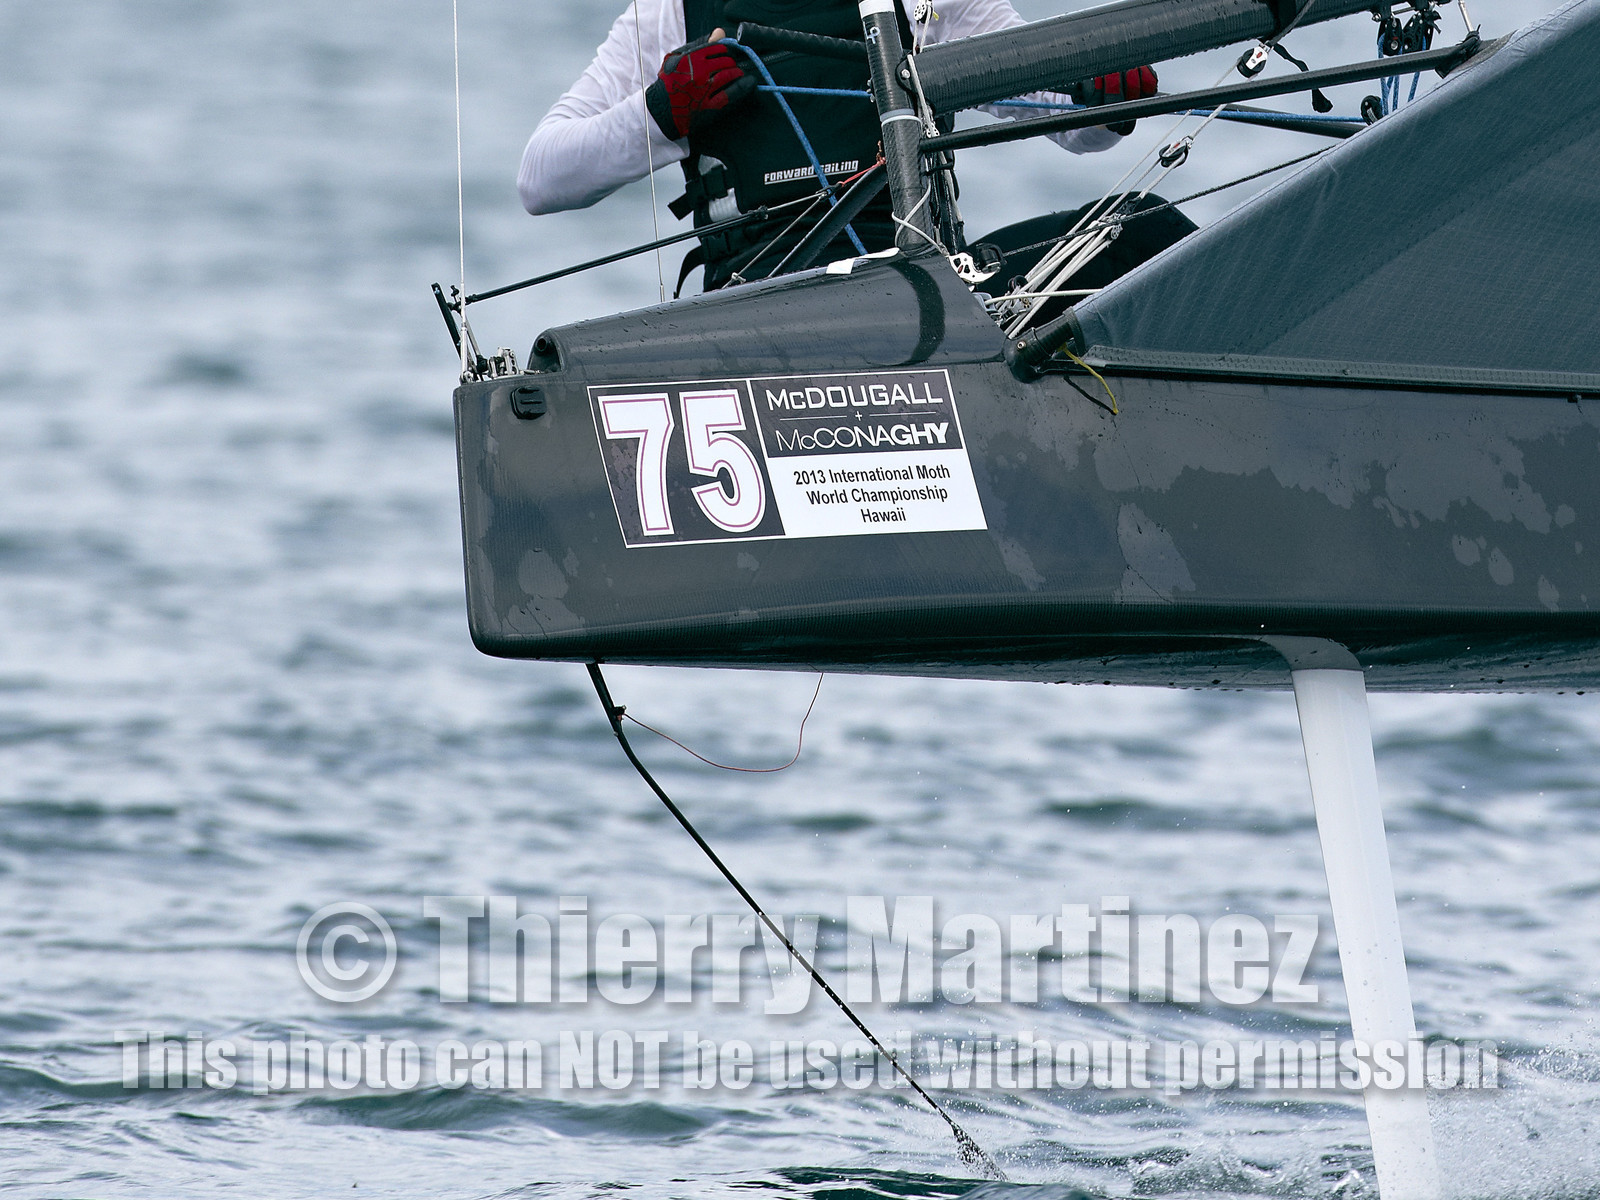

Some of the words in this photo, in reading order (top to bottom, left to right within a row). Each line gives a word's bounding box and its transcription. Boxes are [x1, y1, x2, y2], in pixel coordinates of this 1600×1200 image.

[765, 382, 944, 411] McDOUGALL
[775, 421, 949, 451] McCONAGHY
[597, 388, 766, 537] 75
[793, 469, 826, 485] 2013
[828, 465, 914, 484] International
[915, 464, 951, 479] Moth
[806, 488, 849, 505] World
[851, 485, 948, 504] Championship
[860, 507, 906, 523] Hawaii
